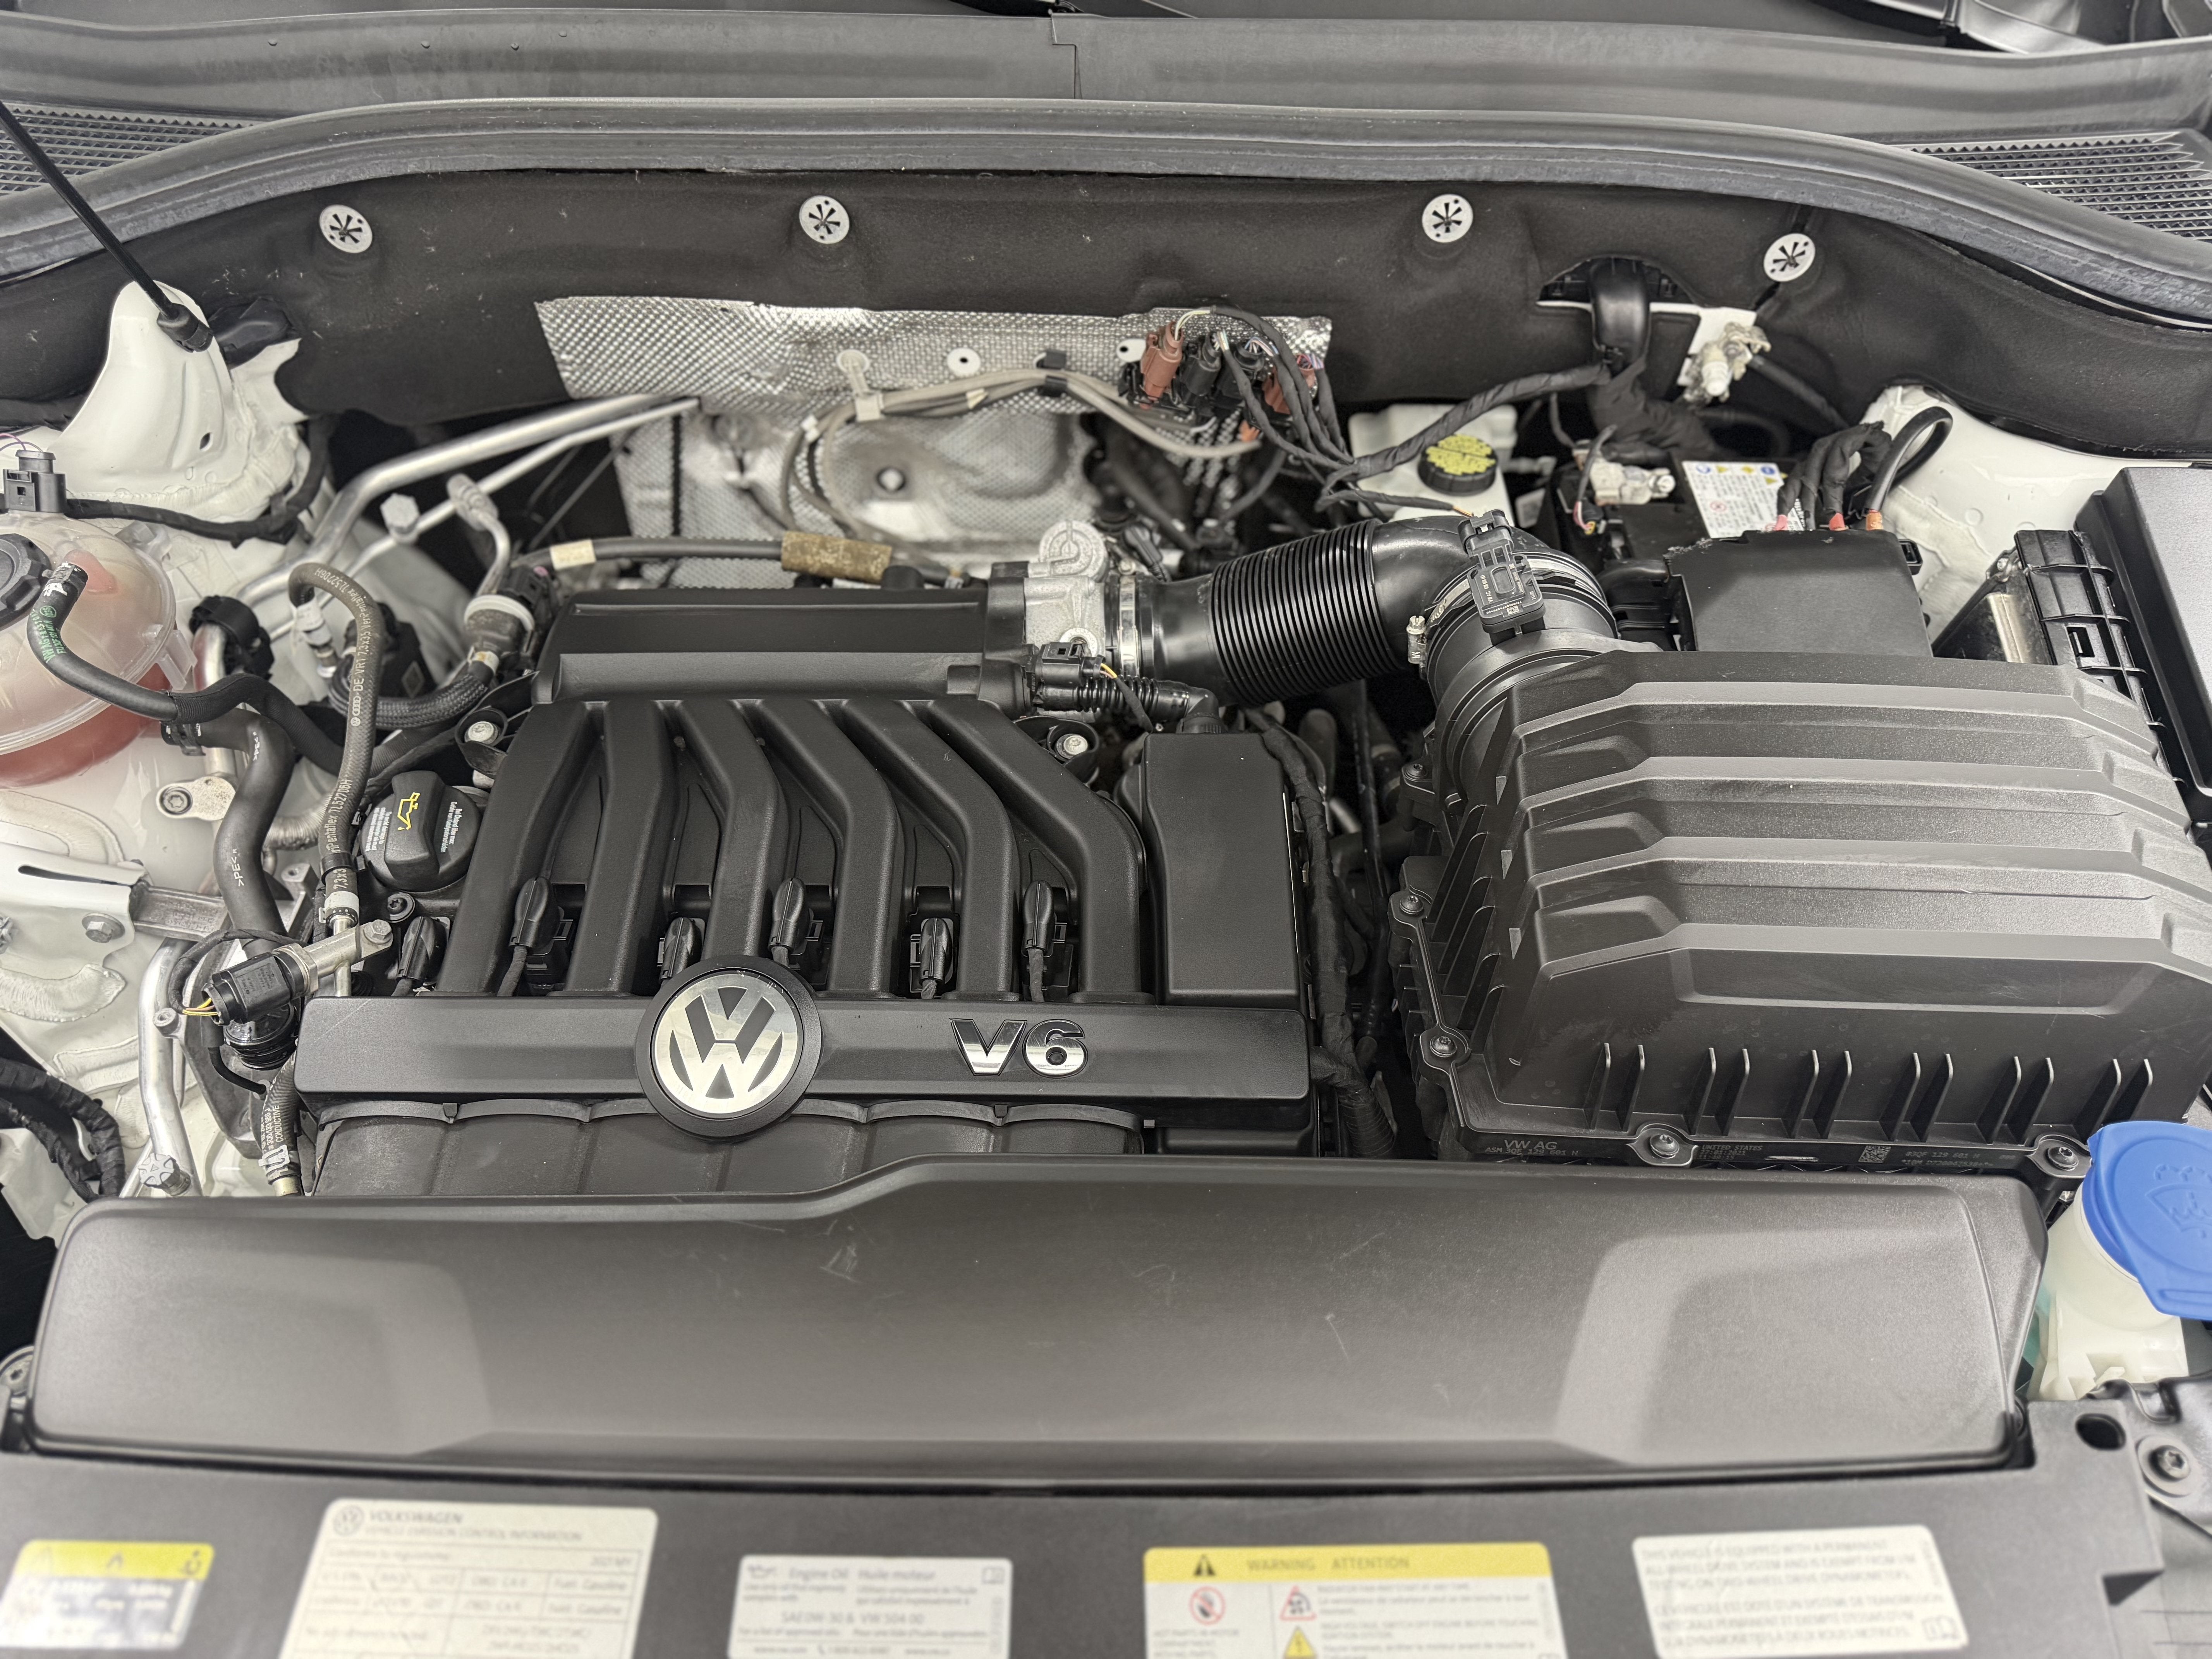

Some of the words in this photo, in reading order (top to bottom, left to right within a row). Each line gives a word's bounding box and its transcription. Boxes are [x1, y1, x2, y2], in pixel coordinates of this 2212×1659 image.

[30, 609, 49, 638] TRISTON
[39, 640, 52, 649] AG
[42, 649, 56, 663] VW
[352, 656, 366, 676] VRT
[352, 678, 365, 692] DE
[332, 779, 353, 812] TL52706H
[449, 801, 458, 812] Gefahr
[370, 813, 378, 825] exceed
[324, 815, 341, 853] riPentaflex
[367, 825, 375, 842] maximum
[374, 821, 383, 836] converter
[378, 826, 388, 840] damage
[450, 827, 459, 836] über
[333, 868, 347, 890] 7,3x3
[949, 1018, 1088, 1077] V6
[273, 1105, 284, 1142] CONDUCTIVE
[1504, 1140, 1530, 1149] VW
[1533, 1141, 1558, 1150] AG
[369, 1511, 464, 1524] VOLKSWAGEN
[510, 1530, 583, 1541] INFORMATION
[1247, 1558, 1316, 1572] WARNING
[1332, 1556, 1410, 1571] ATTENTION
[788, 1568, 828, 1582] Engine
[831, 1568, 849, 1580] Oil
[857, 1569, 889, 1580] Huile
[892, 1570, 936, 1580] moteur
[781, 1611, 803, 1624] SAE
[860, 1613, 880, 1624] VW
[884, 1613, 907, 1625] 504
